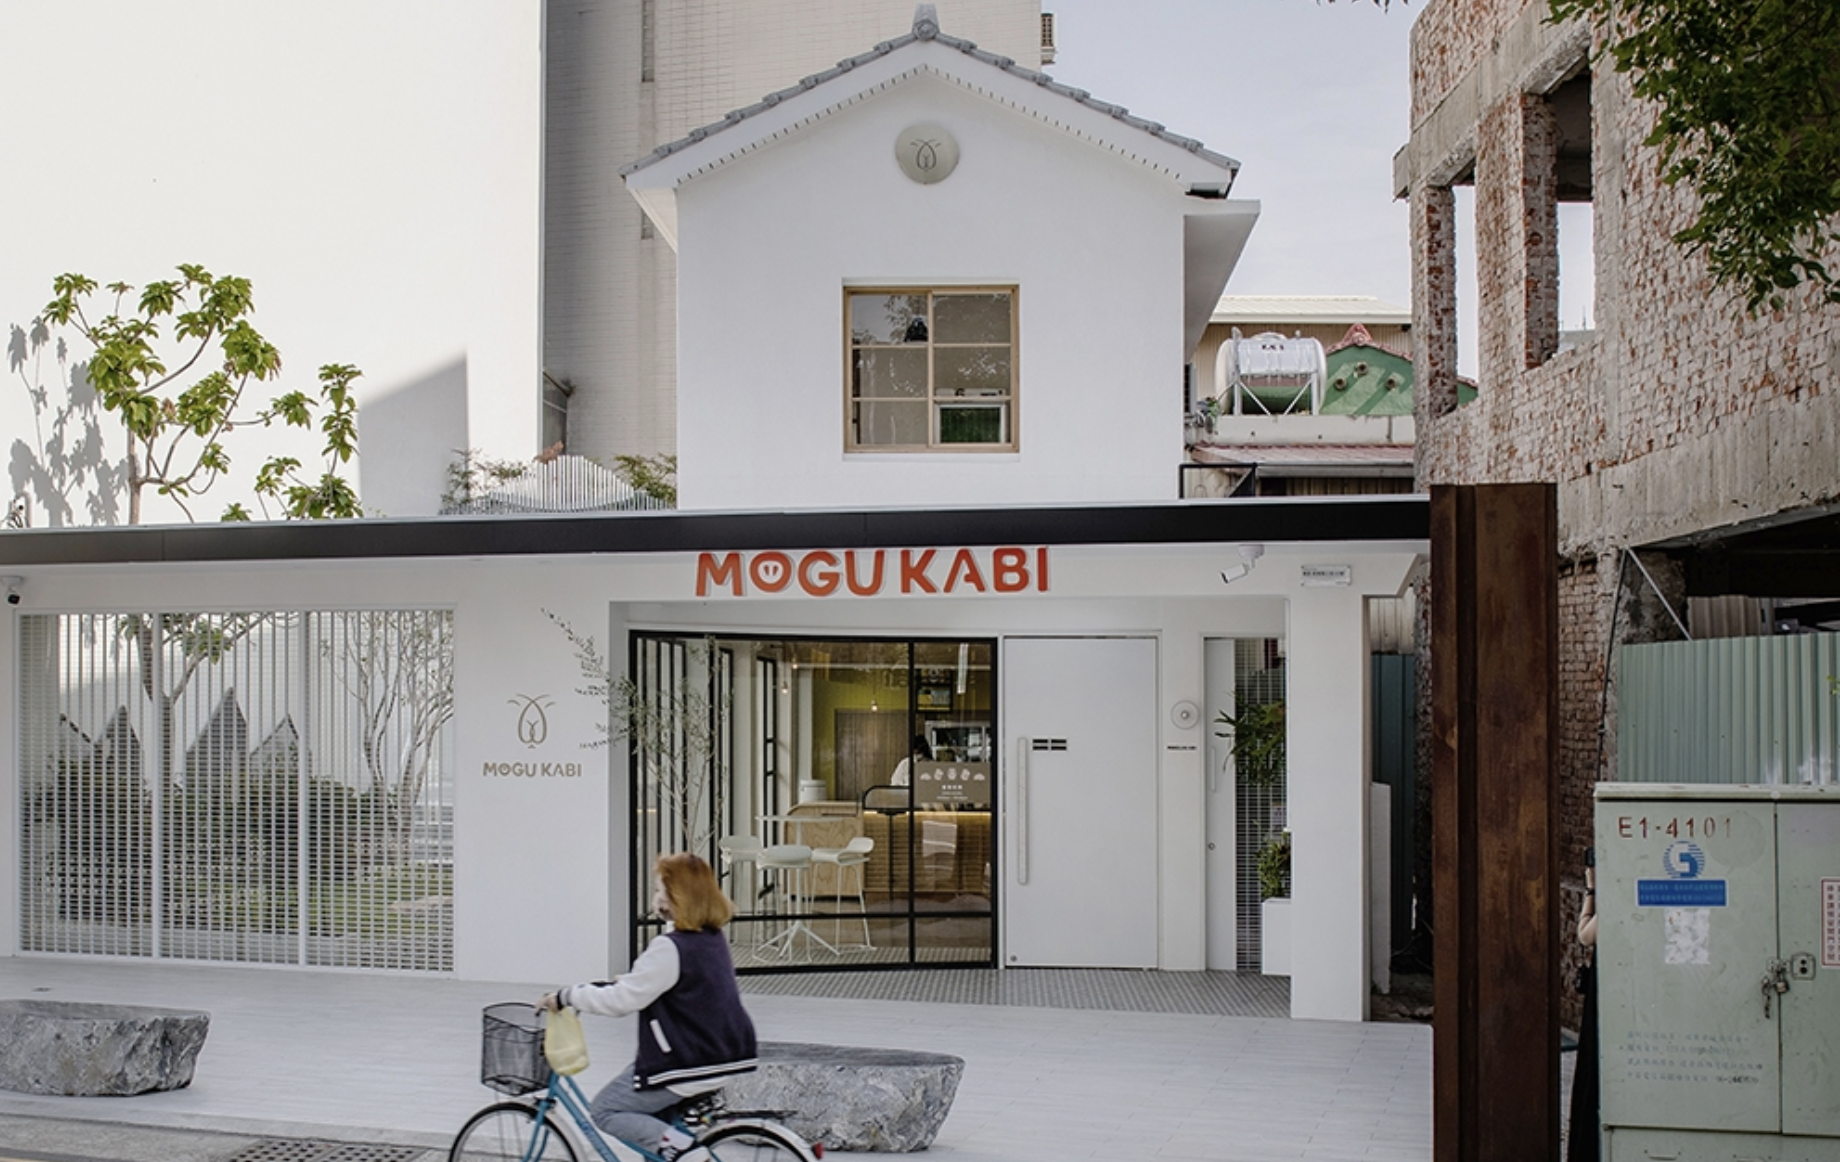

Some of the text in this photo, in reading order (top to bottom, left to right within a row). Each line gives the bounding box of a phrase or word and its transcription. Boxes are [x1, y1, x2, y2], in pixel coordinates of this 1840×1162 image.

[695, 546, 1050, 597] MOGU KABI
[483, 762, 582, 777] MOGU KABI
